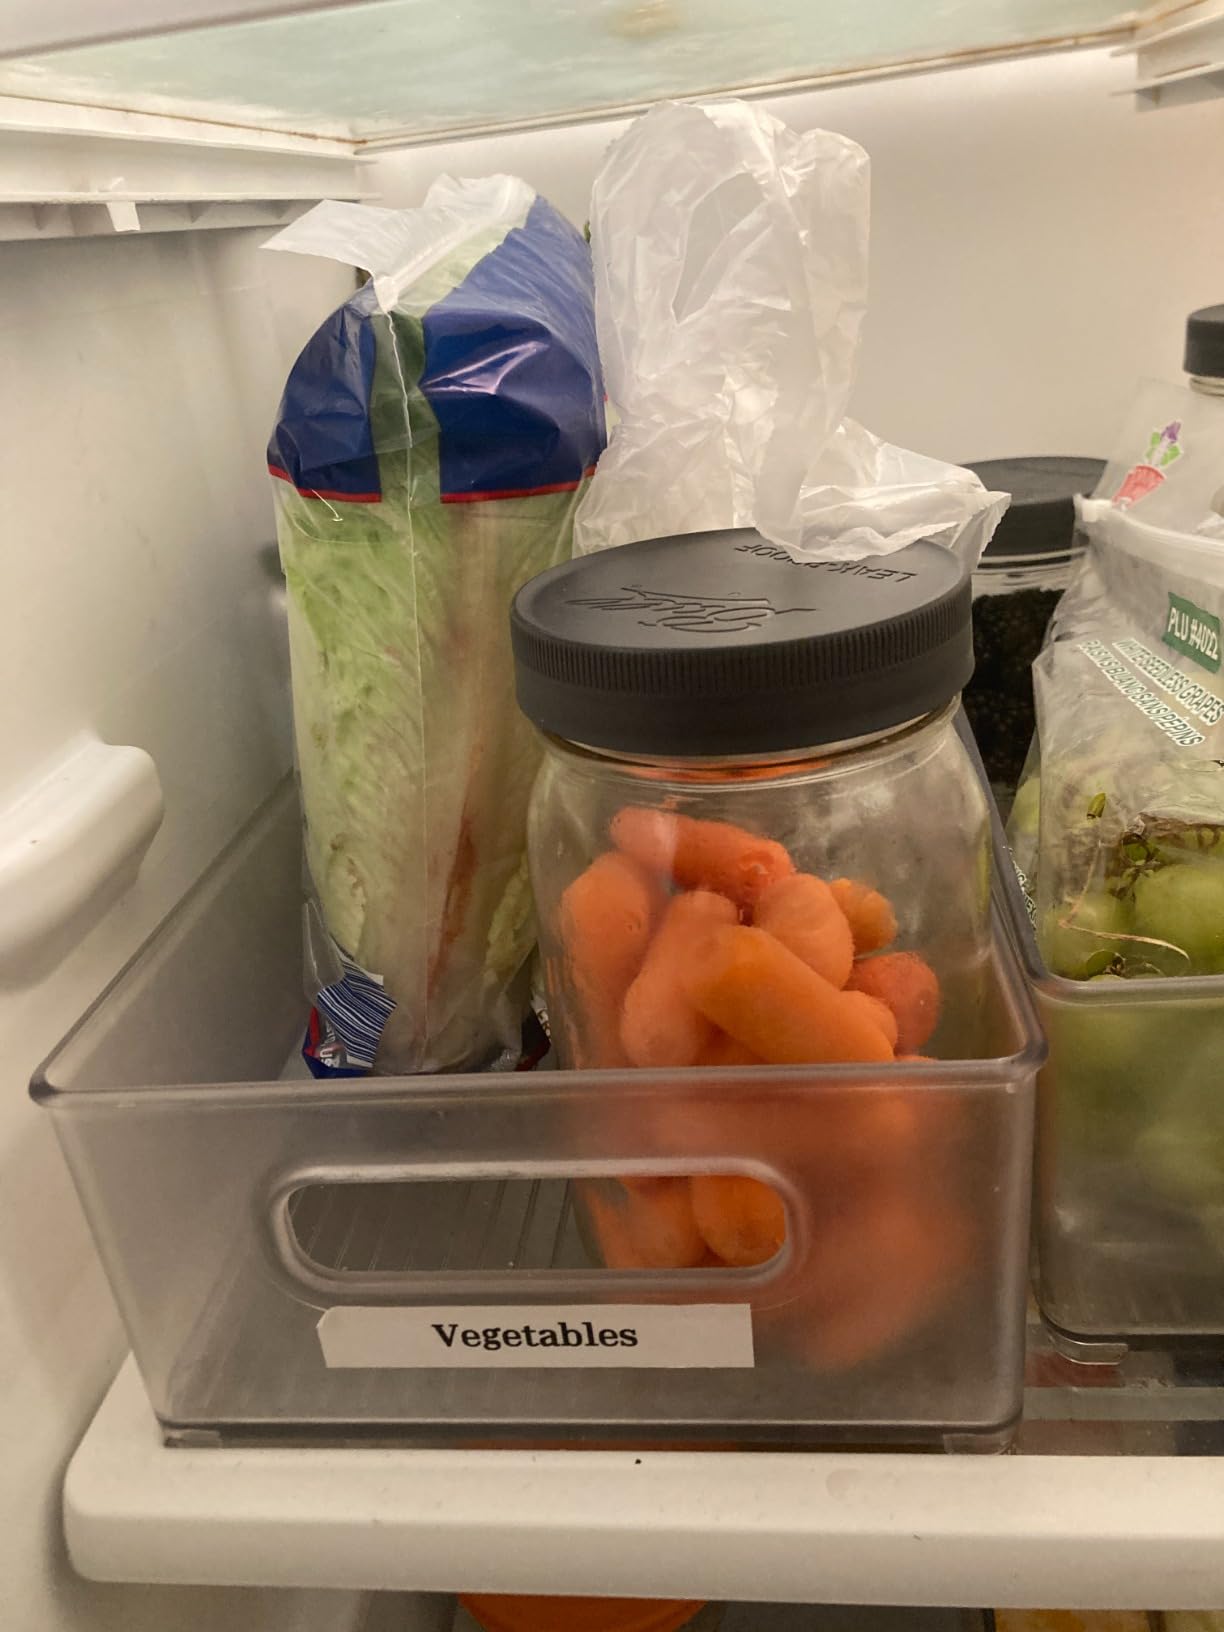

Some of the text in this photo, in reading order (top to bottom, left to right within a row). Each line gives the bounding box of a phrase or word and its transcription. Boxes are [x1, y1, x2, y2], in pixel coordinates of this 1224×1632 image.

[734, 544, 917, 583] LEAK-POOF
[1167, 606, 1219, 661] PLU #4022
[1081, 640, 1119, 668] RAISINS
[1130, 692, 1169, 715] SANS
[1138, 655, 1190, 693] SEEDLESS
[1178, 684, 1224, 724] GRAPES
[431, 1321, 638, 1351] Vegetables
